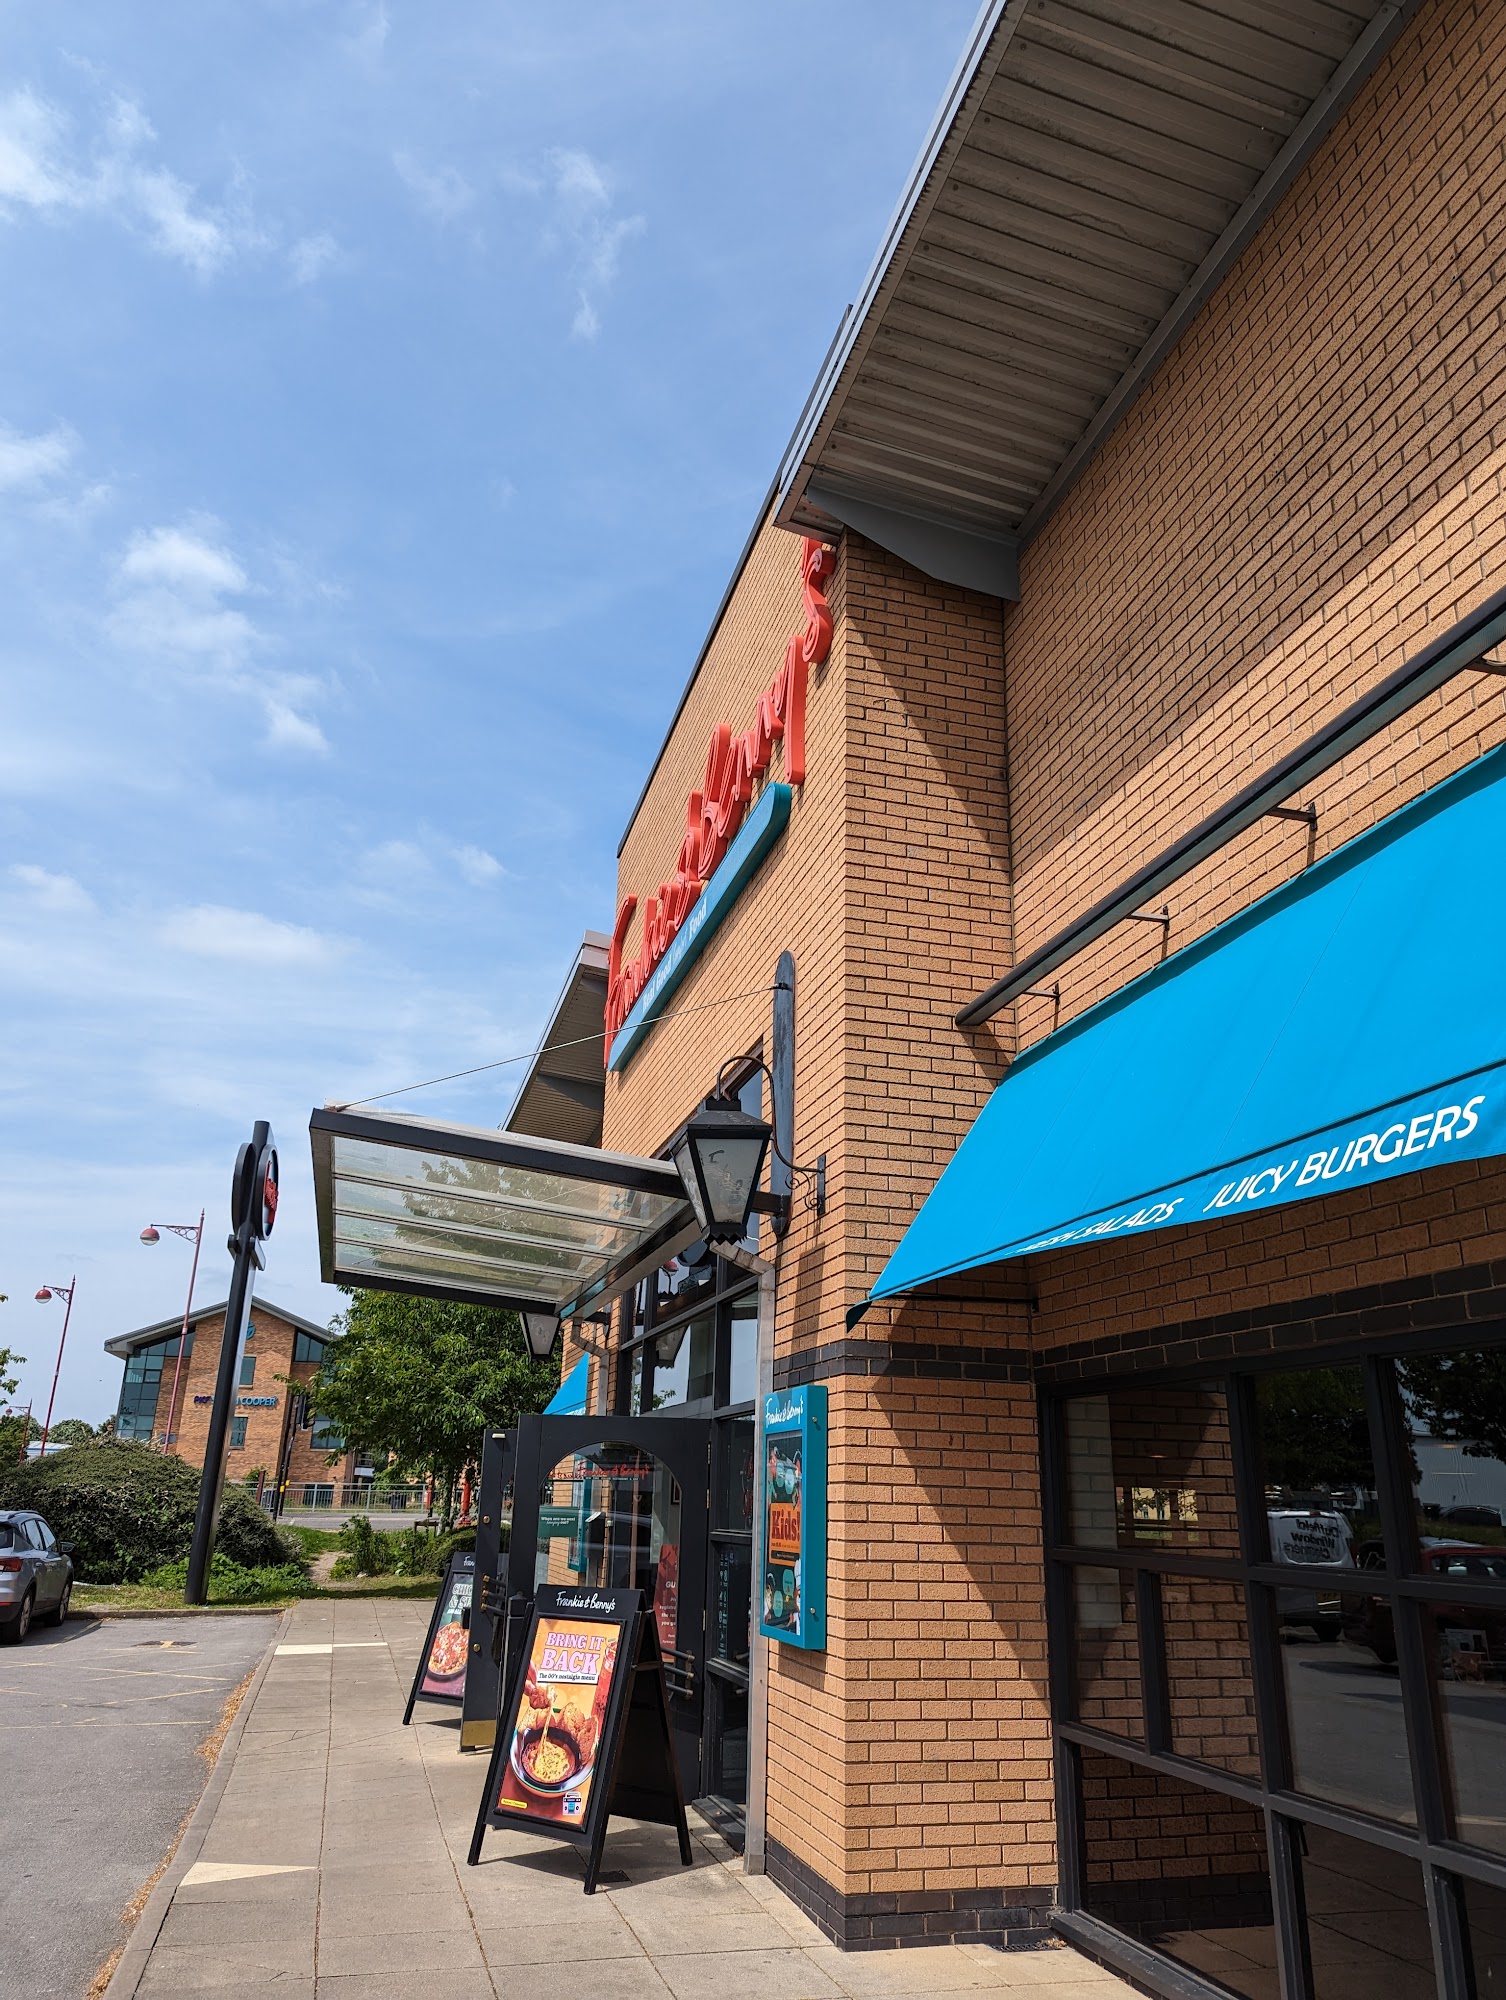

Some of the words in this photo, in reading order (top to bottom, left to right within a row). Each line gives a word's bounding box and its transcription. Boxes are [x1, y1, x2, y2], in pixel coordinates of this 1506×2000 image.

[689, 896, 707, 941] Food
[1073, 1197, 1185, 1241] SALADS
[1202, 1159, 1299, 1213] JUICY
[1294, 1095, 1486, 1188] BURGERS
[240, 1396, 276, 1406] COOPER
[771, 1510, 800, 1541] Kids!
[448, 1594, 459, 1609] &
[556, 1591, 584, 1607] Frankie
[583, 1595, 590, 1608] &
[590, 1593, 615, 1613] Benny's
[546, 1632, 588, 1648] BRING
[588, 1636, 603, 1650] IT
[541, 1649, 599, 1674] BACK
[559, 1673, 580, 1681] nostalgia
